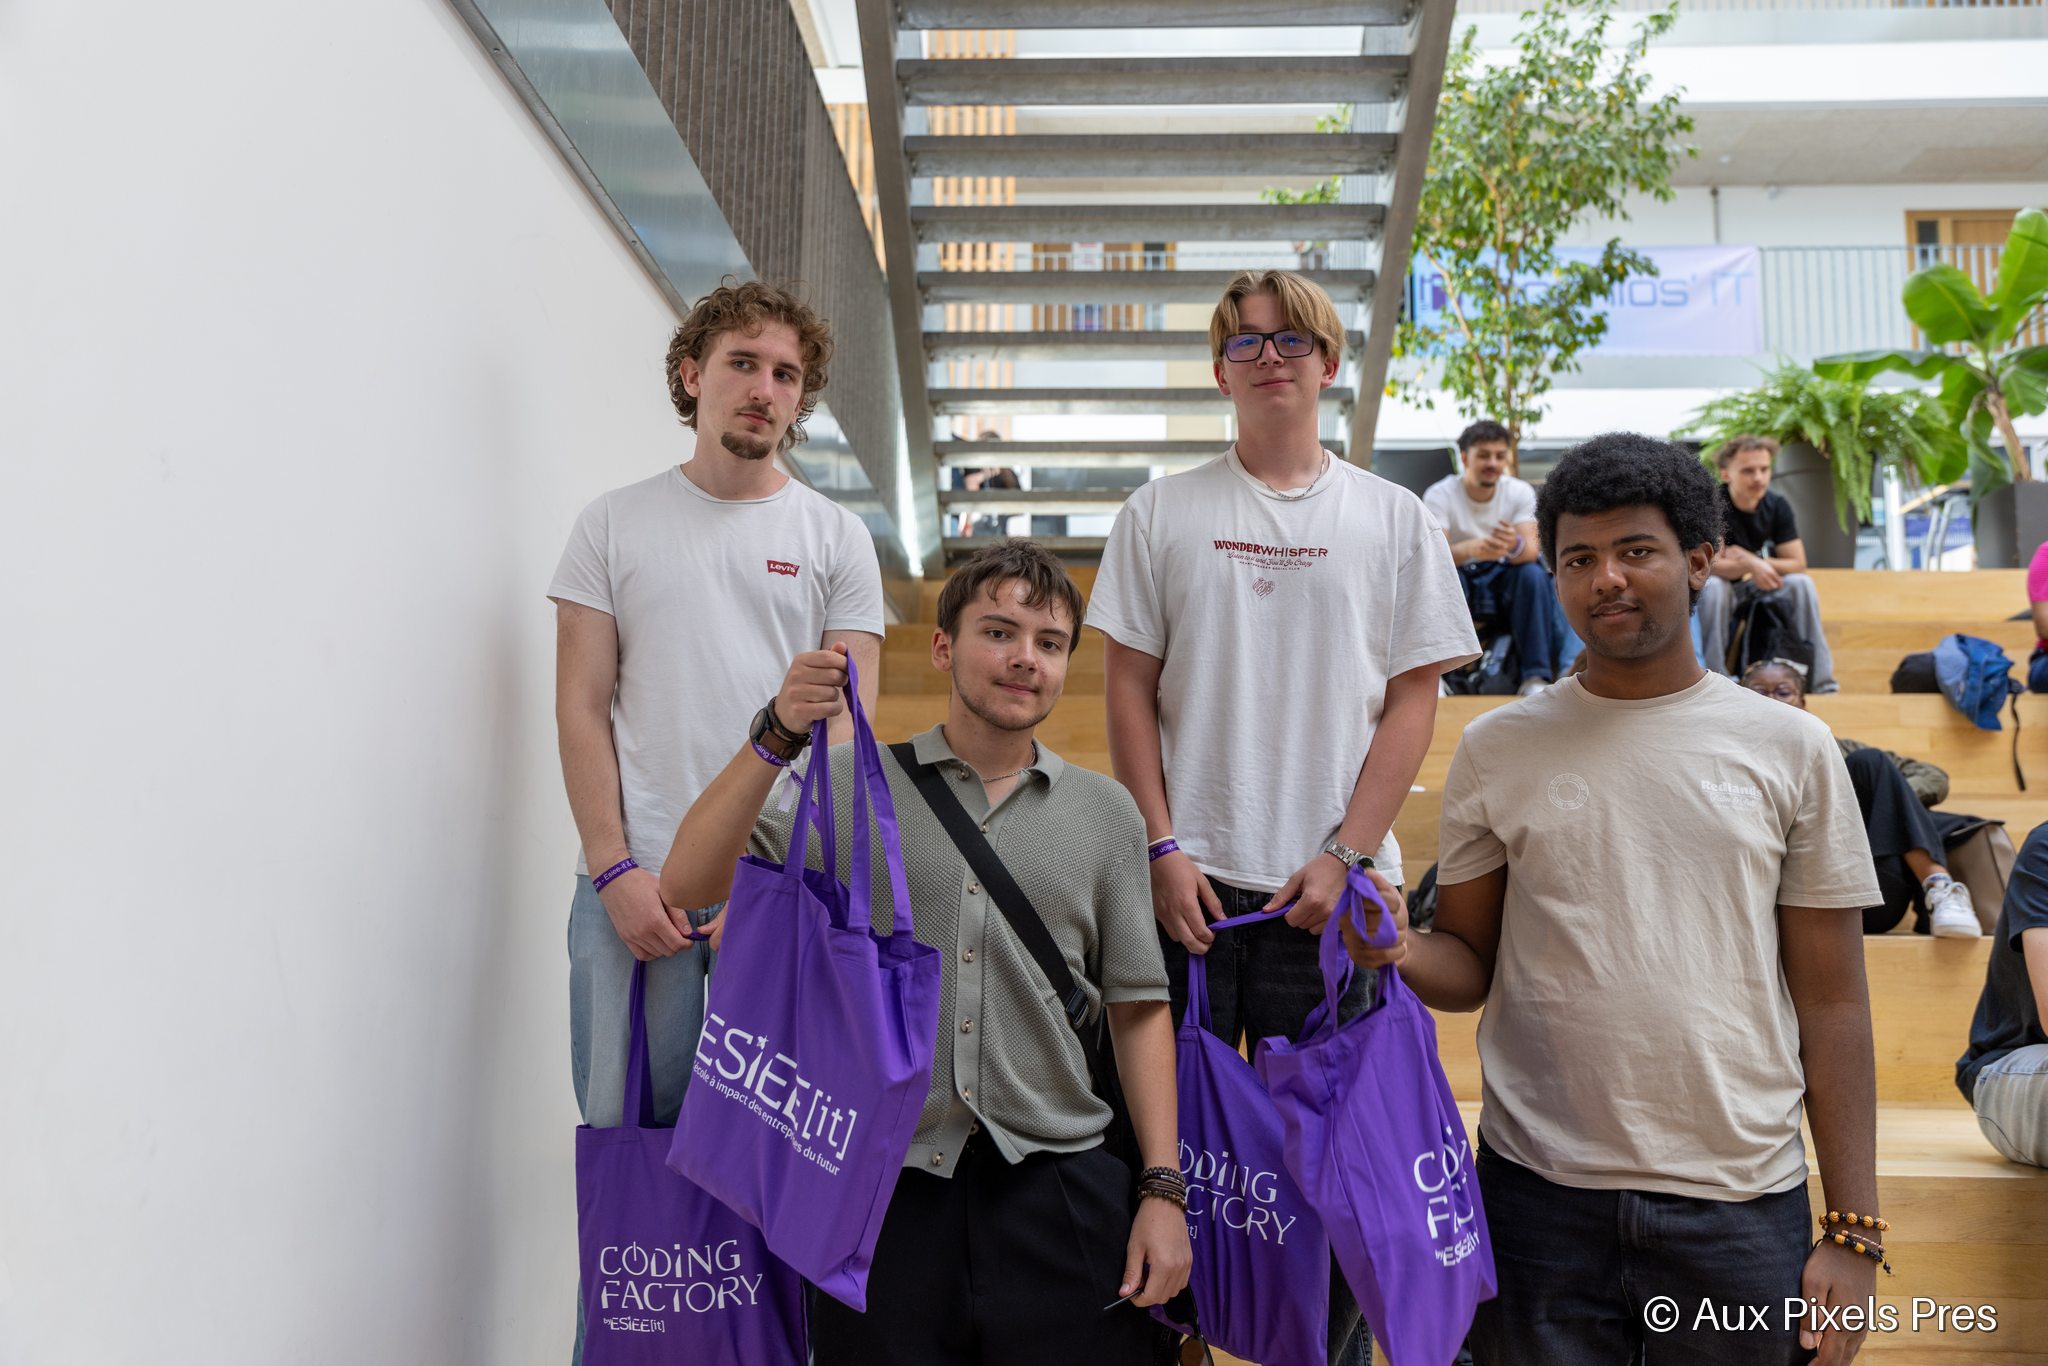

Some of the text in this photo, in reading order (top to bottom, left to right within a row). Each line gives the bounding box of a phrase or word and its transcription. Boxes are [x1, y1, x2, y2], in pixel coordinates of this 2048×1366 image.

[1213, 540, 1328, 557] WONDERWHISPER
[1701, 780, 1763, 798] Redlands
[709, 1075, 716, 1087] à
[715, 1079, 748, 1106] impact
[748, 1099, 763, 1116] des
[803, 1146, 816, 1161] du
[816, 1153, 840, 1176] futur
[1185, 1184, 1296, 1245] CTORY
[601, 1273, 763, 1313] FACTORY
